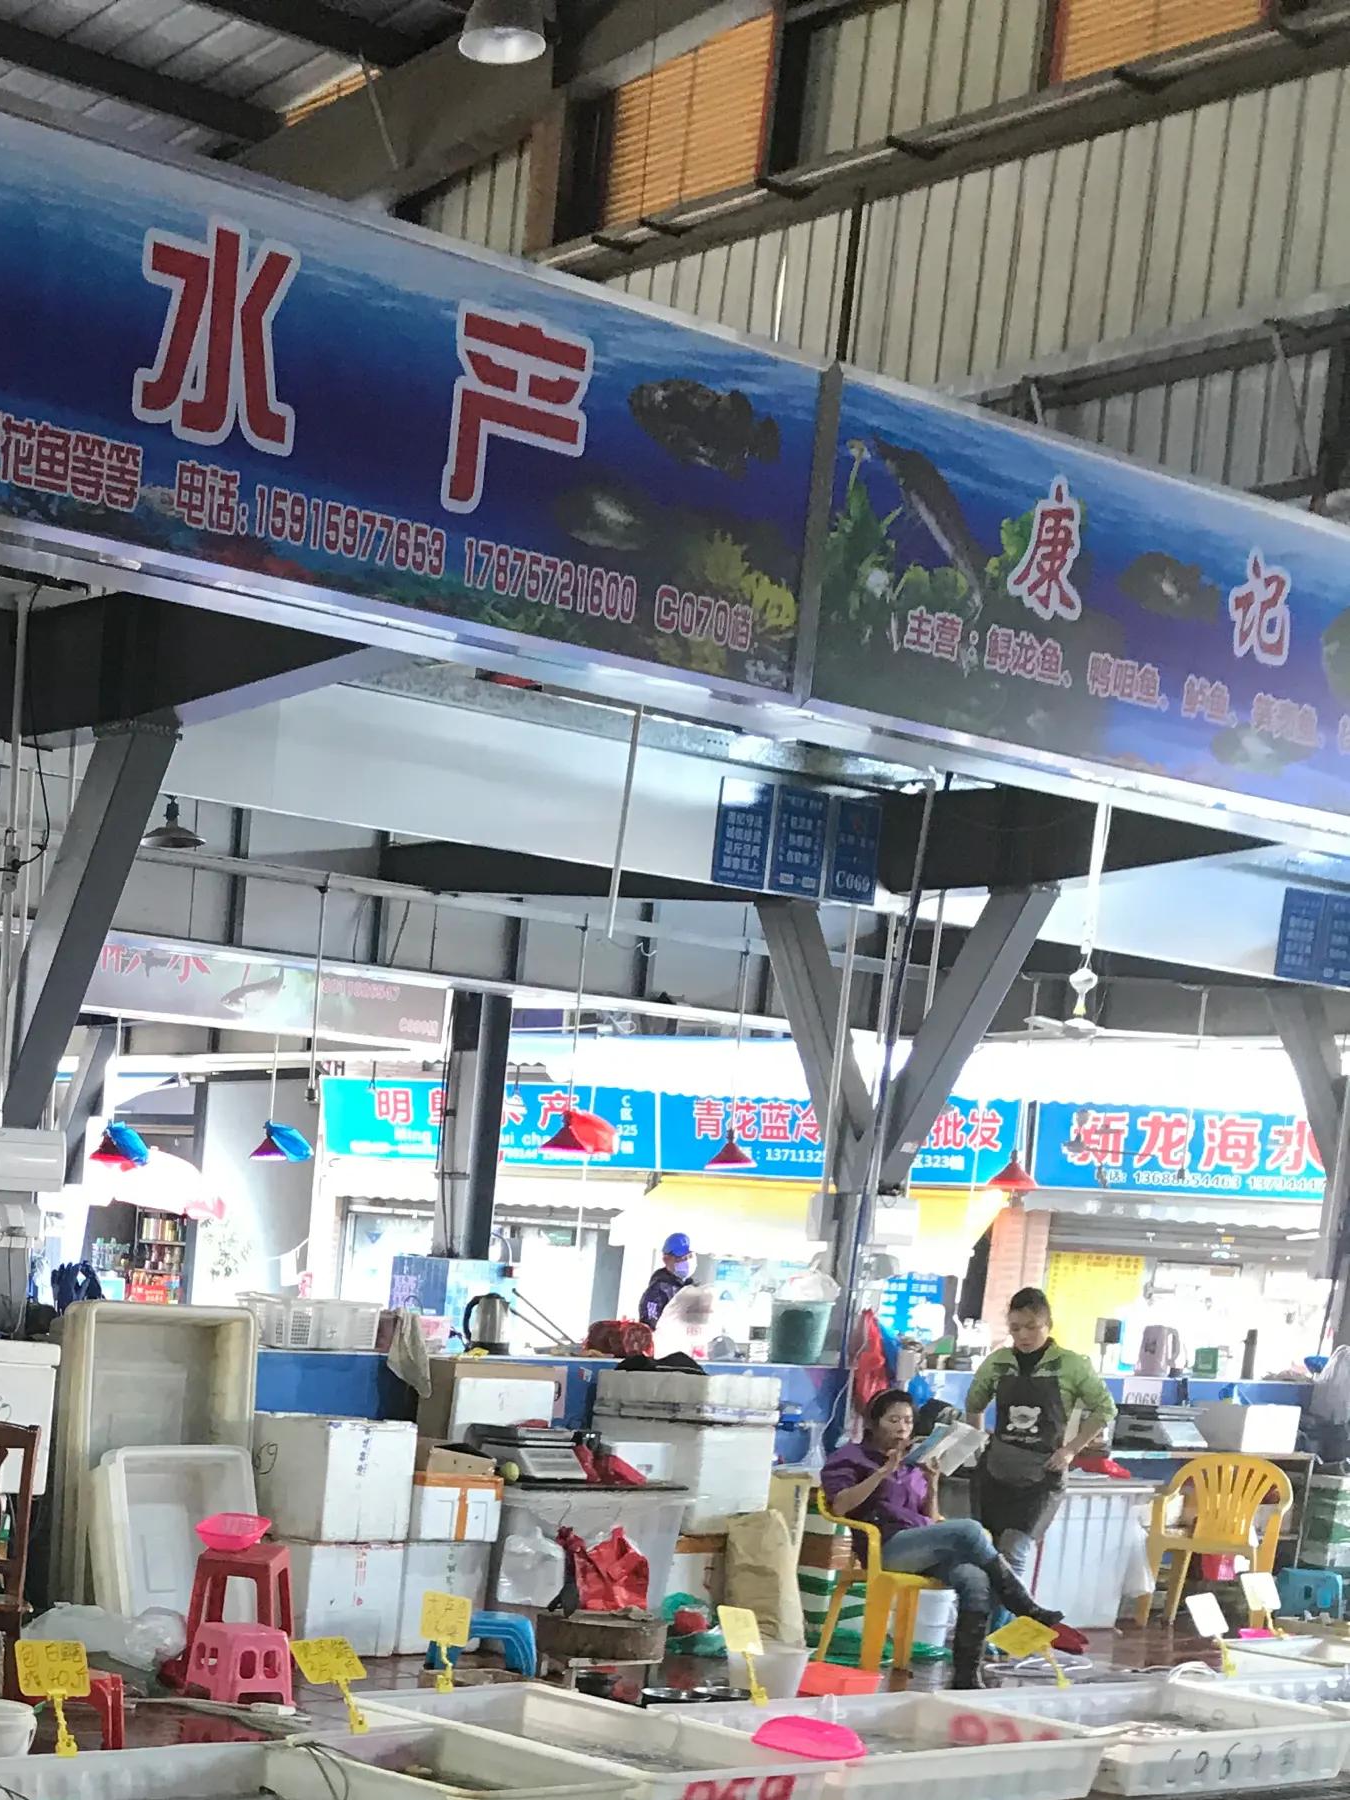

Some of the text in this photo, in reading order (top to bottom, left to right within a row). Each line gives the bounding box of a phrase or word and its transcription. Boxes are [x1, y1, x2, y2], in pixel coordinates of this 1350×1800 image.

[463, 537, 637, 624] 17875721600
[1008, 475, 1290, 665] 康记
[836, 869, 871, 892] C069
